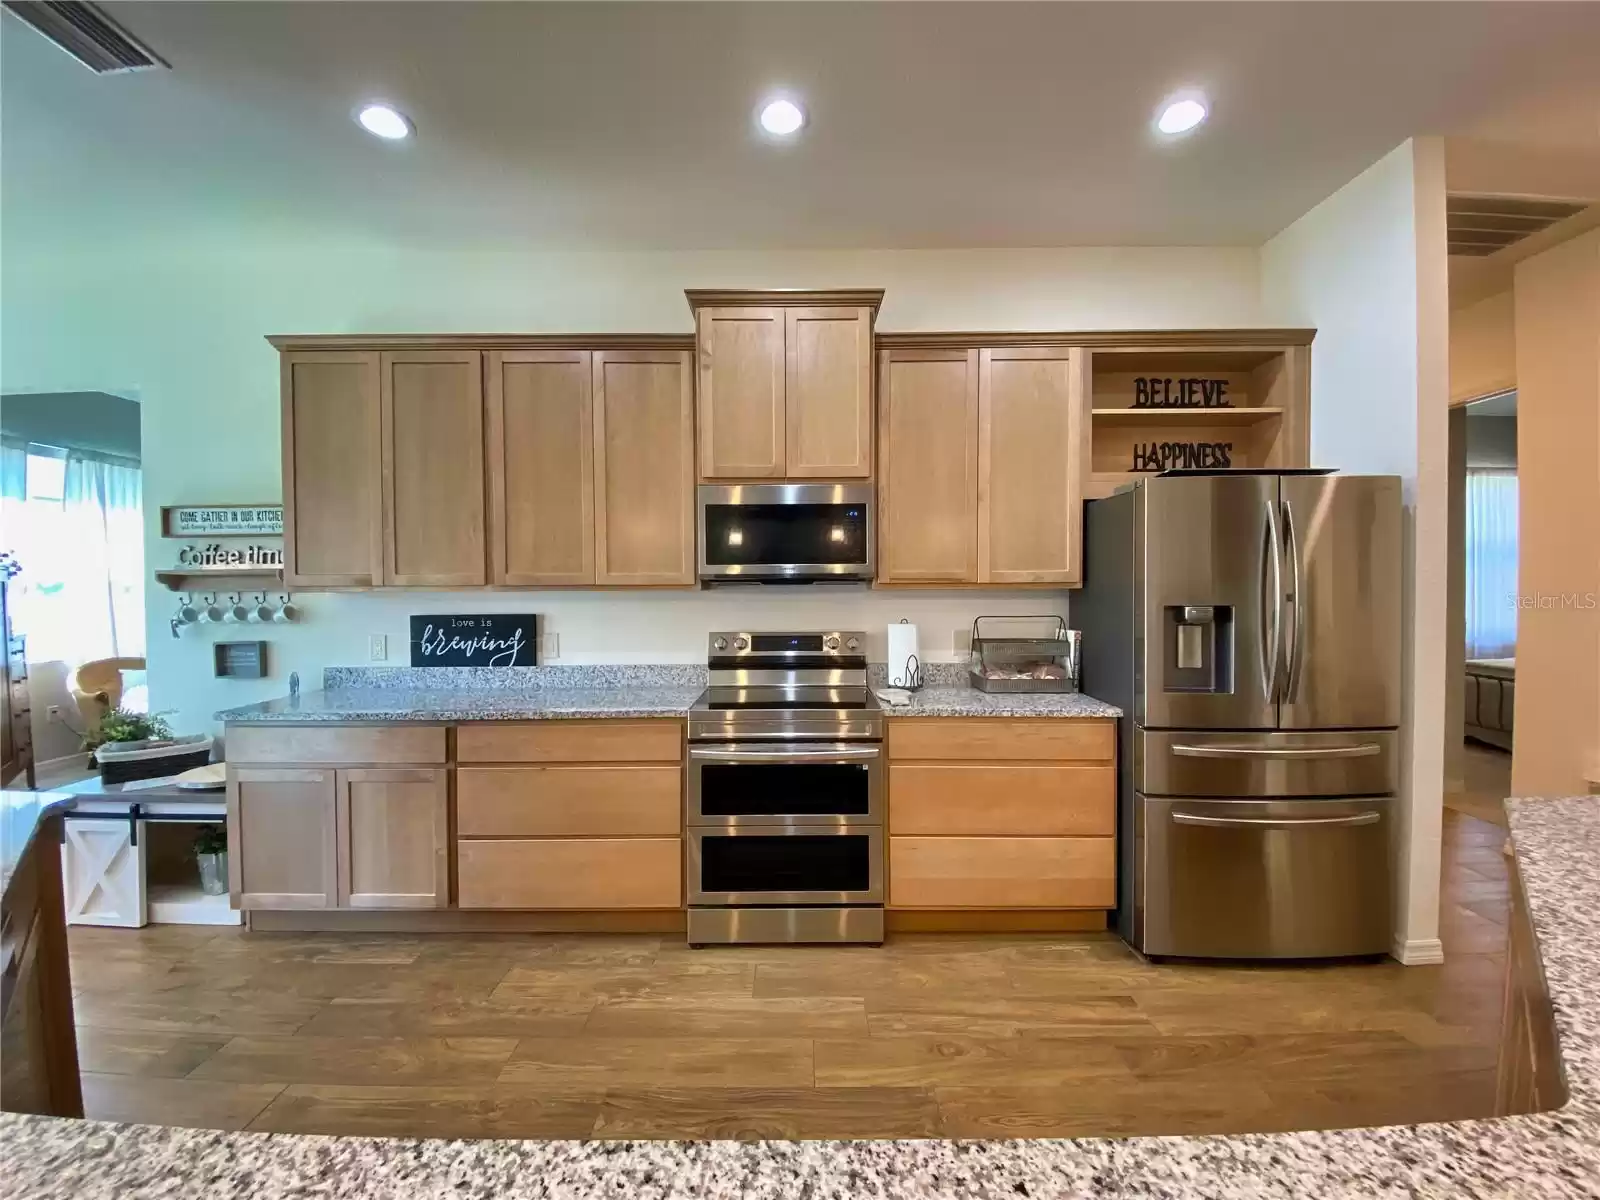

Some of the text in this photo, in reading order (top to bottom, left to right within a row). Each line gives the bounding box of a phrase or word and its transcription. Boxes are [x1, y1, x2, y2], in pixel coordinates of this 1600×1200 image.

[1134, 378, 1230, 407] BELIEVE
[1133, 442, 1232, 469] HAPPINESS
[180, 511, 198, 522] COME
[201, 511, 228, 522] GATHER
[231, 511, 238, 522] IN
[241, 511, 254, 522] OUR
[180, 545, 241, 566] Coffee
[451, 618, 492, 627] love is
[420, 624, 526, 667] brewing
